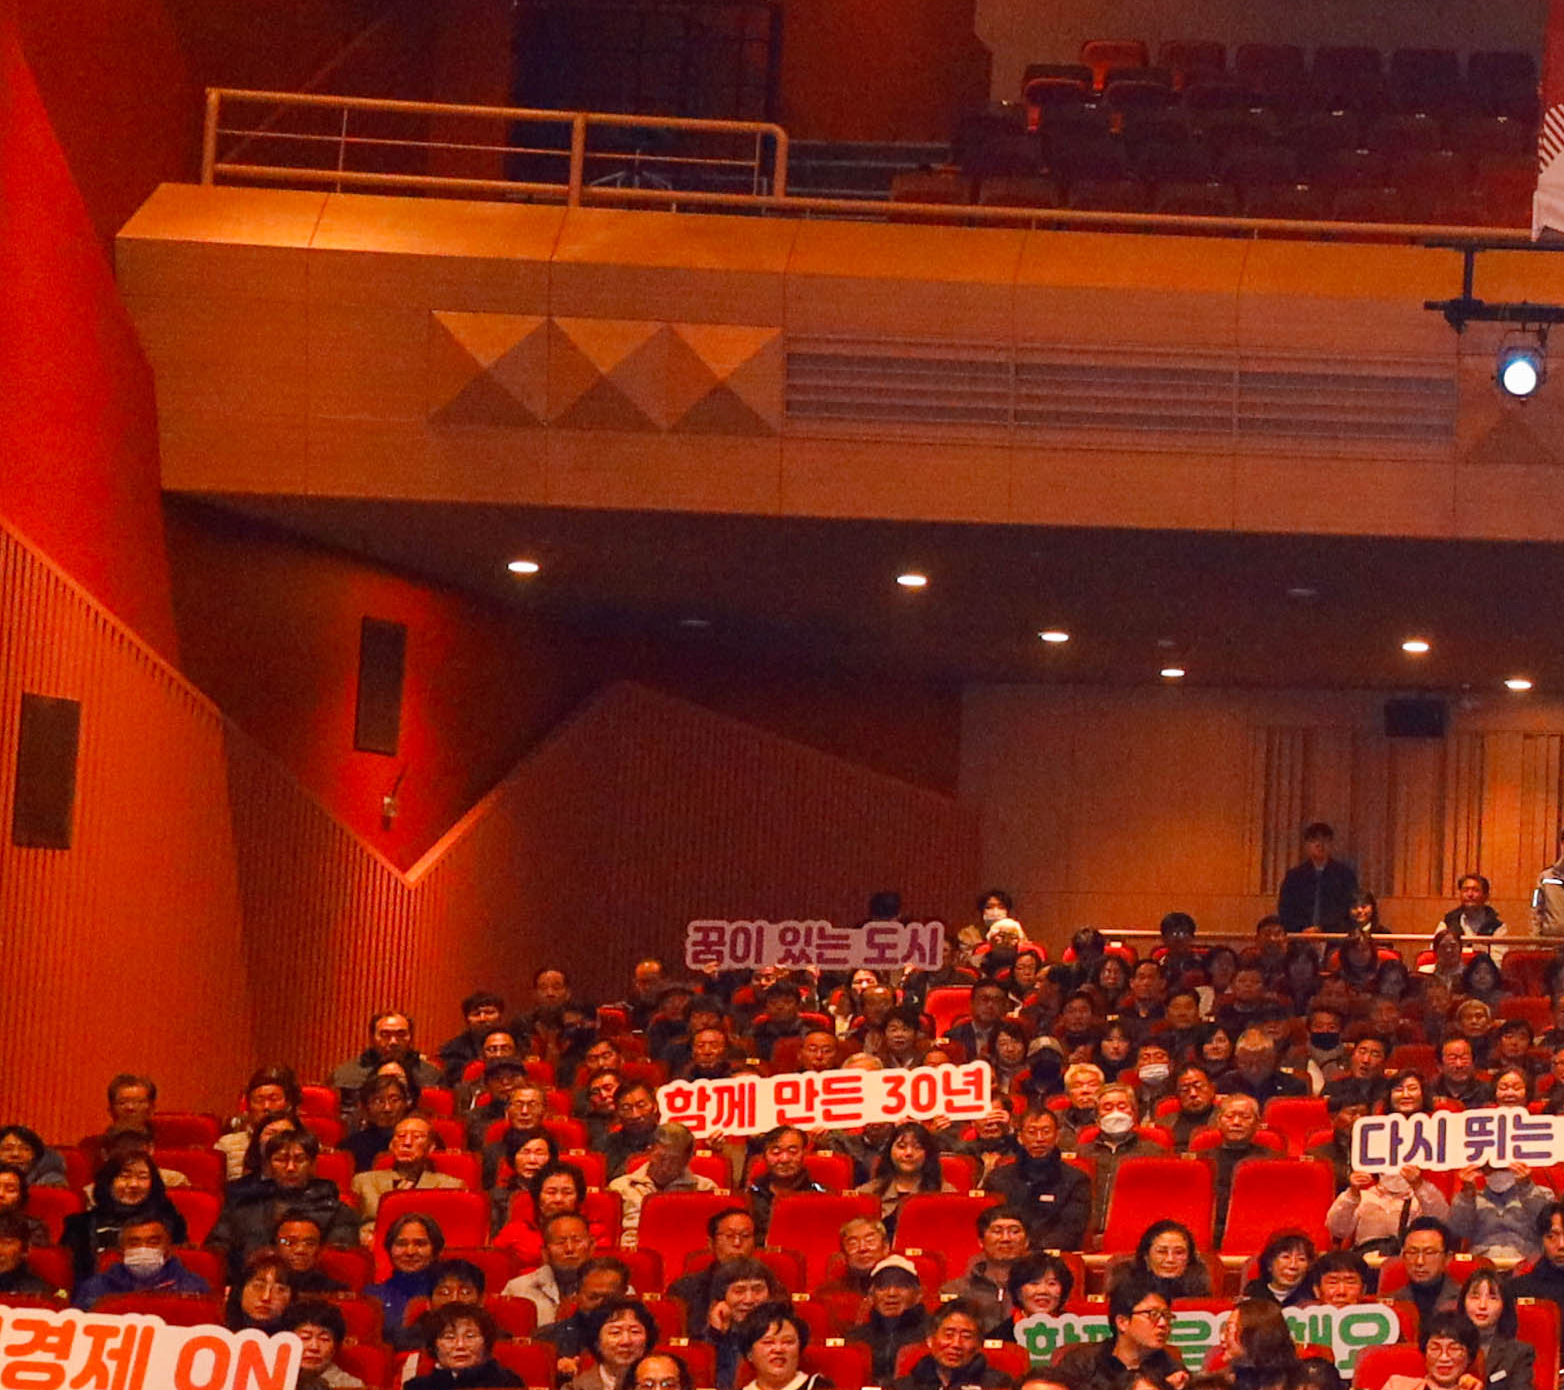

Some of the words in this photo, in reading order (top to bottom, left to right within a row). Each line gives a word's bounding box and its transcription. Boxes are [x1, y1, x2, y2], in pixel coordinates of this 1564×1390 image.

[691, 925, 770, 968] 꿈이
[777, 924, 854, 966] 있는
[862, 923, 942, 968] 도시
[664, 1080, 756, 1130] 함께
[773, 1074, 865, 1123] 만든
[880, 1066, 985, 1112] 30년
[1358, 1115, 1448, 1168] 다시
[1463, 1112, 1557, 1163] 뛰는
